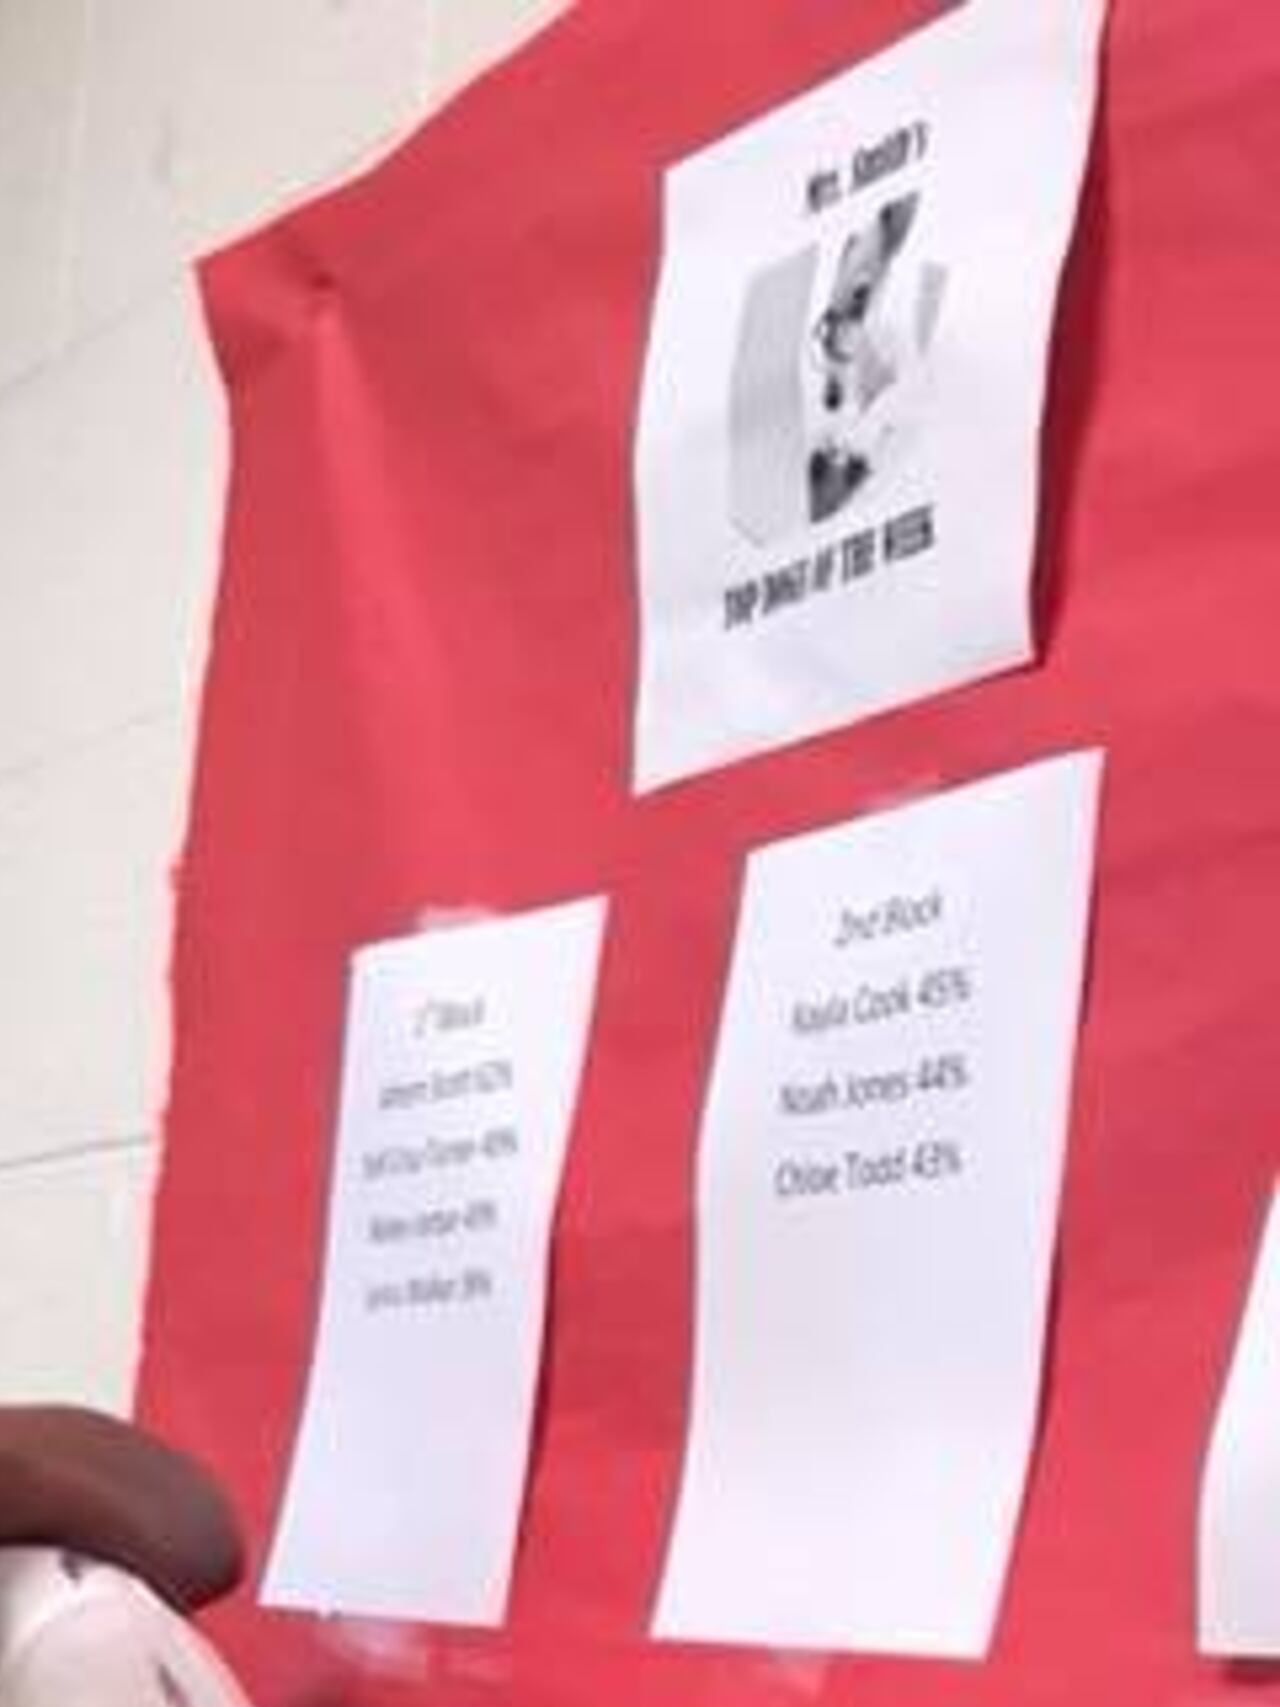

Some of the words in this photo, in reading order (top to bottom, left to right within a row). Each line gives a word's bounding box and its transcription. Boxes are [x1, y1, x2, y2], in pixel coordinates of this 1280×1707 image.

[853, 976, 910, 1024] Cook
[775, 1160, 839, 1201] Chloe
[845, 1148, 906, 1189] Todd
